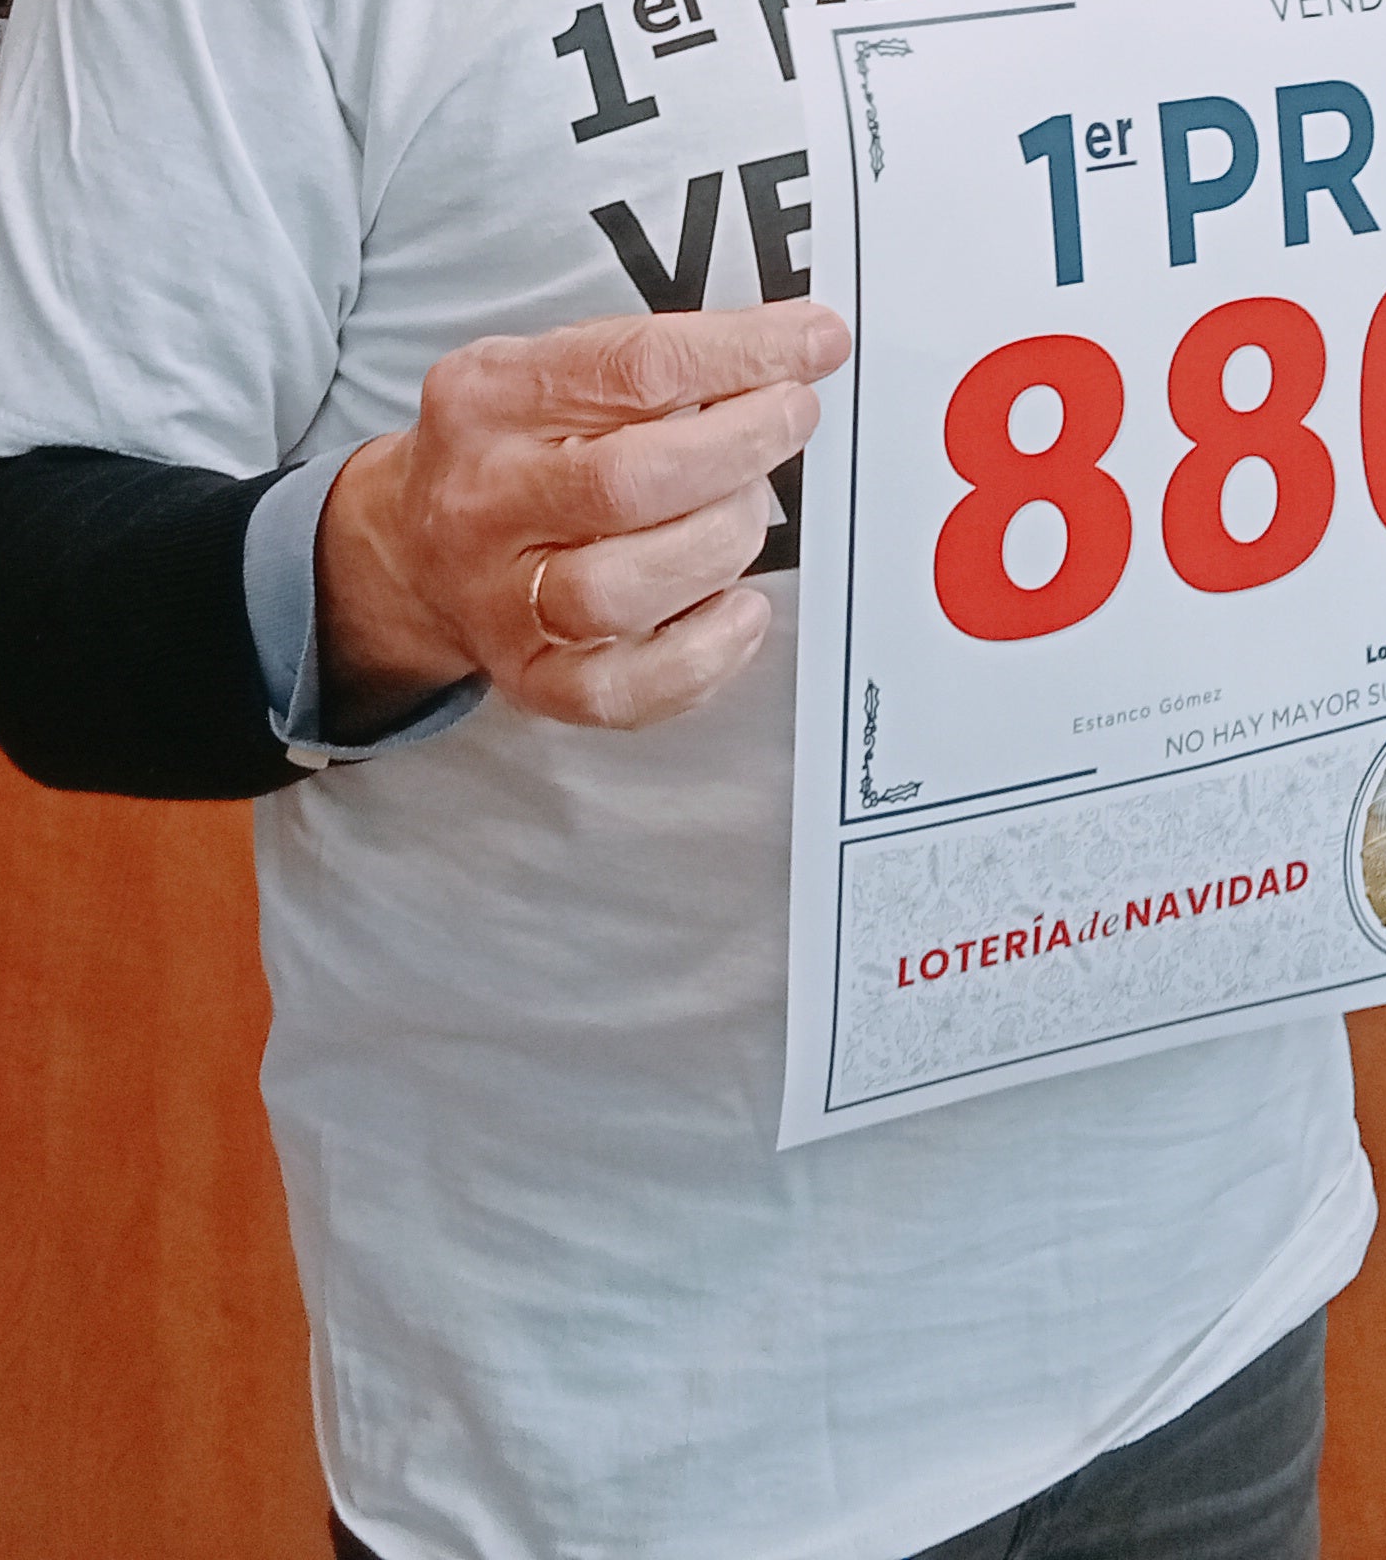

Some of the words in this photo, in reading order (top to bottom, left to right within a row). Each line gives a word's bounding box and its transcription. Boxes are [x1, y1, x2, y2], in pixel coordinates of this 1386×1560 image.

[1018, 112, 1137, 287] 1er
[1072, 704, 1151, 735] Estanco
[1159, 687, 1223, 715] Gómez
[1164, 729, 1205, 760] NO
[1213, 713, 1266, 747] HAY
[1271, 688, 1361, 731] MAYOR
[897, 913, 1073, 988] LOTERÍA
[1124, 860, 1310, 931] NAVIDAD
